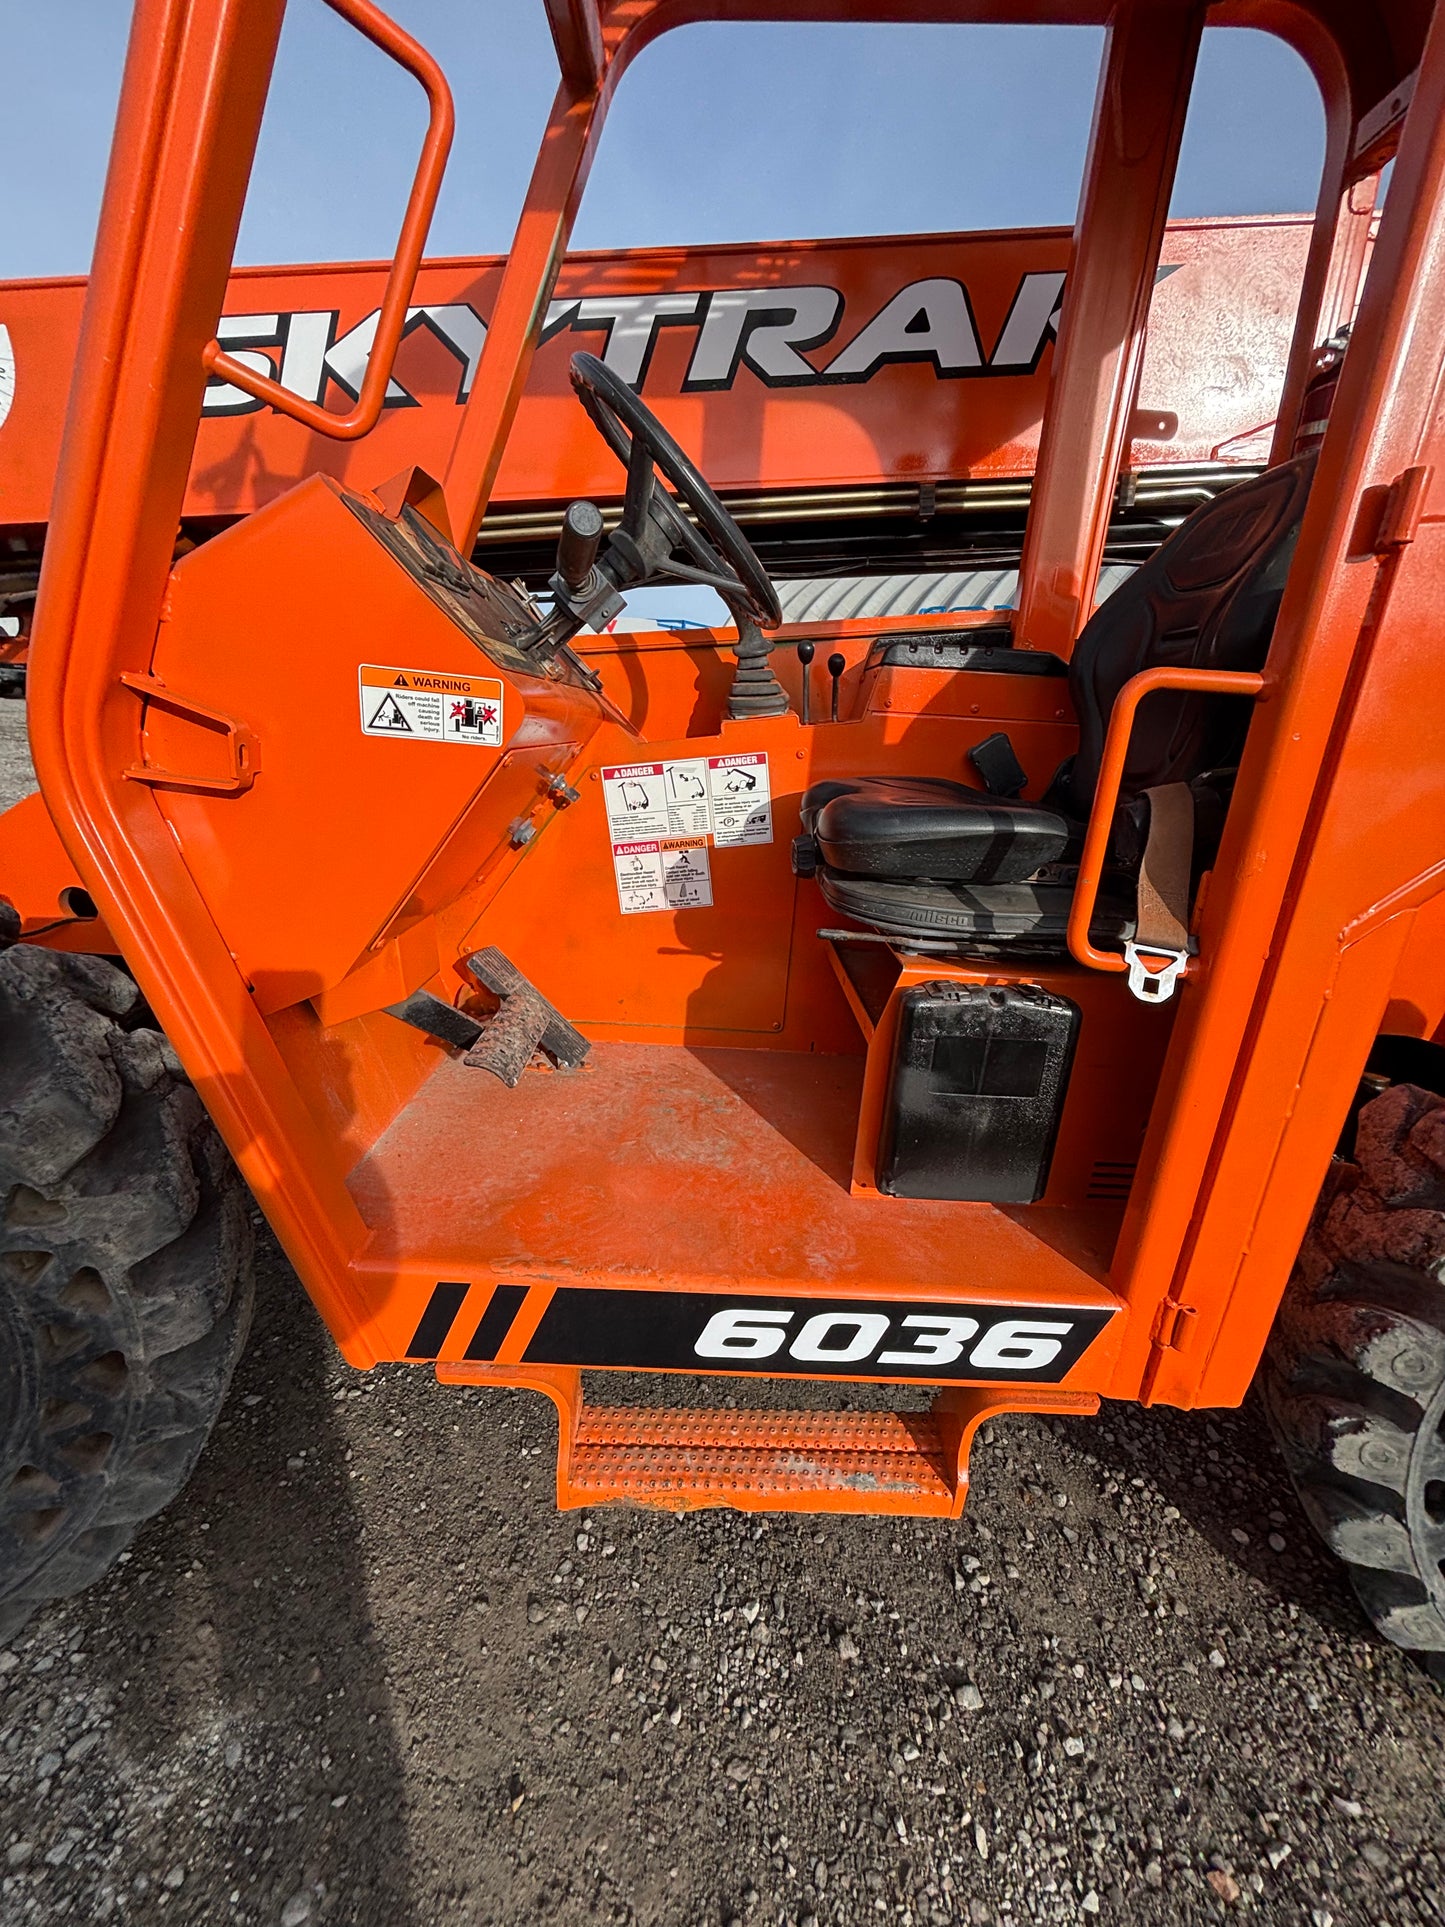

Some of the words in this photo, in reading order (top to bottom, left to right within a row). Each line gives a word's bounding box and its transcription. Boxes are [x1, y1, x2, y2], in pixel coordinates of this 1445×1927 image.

[413, 677, 471, 692] WARNING
[725, 756, 758, 767] DANGER
[620, 766, 654, 778] DANGER
[624, 844, 658, 854] DANGER
[668, 839, 704, 848] WARNING
[908, 910, 968, 926] milsco
[694, 1309, 1074, 1369] 6036
